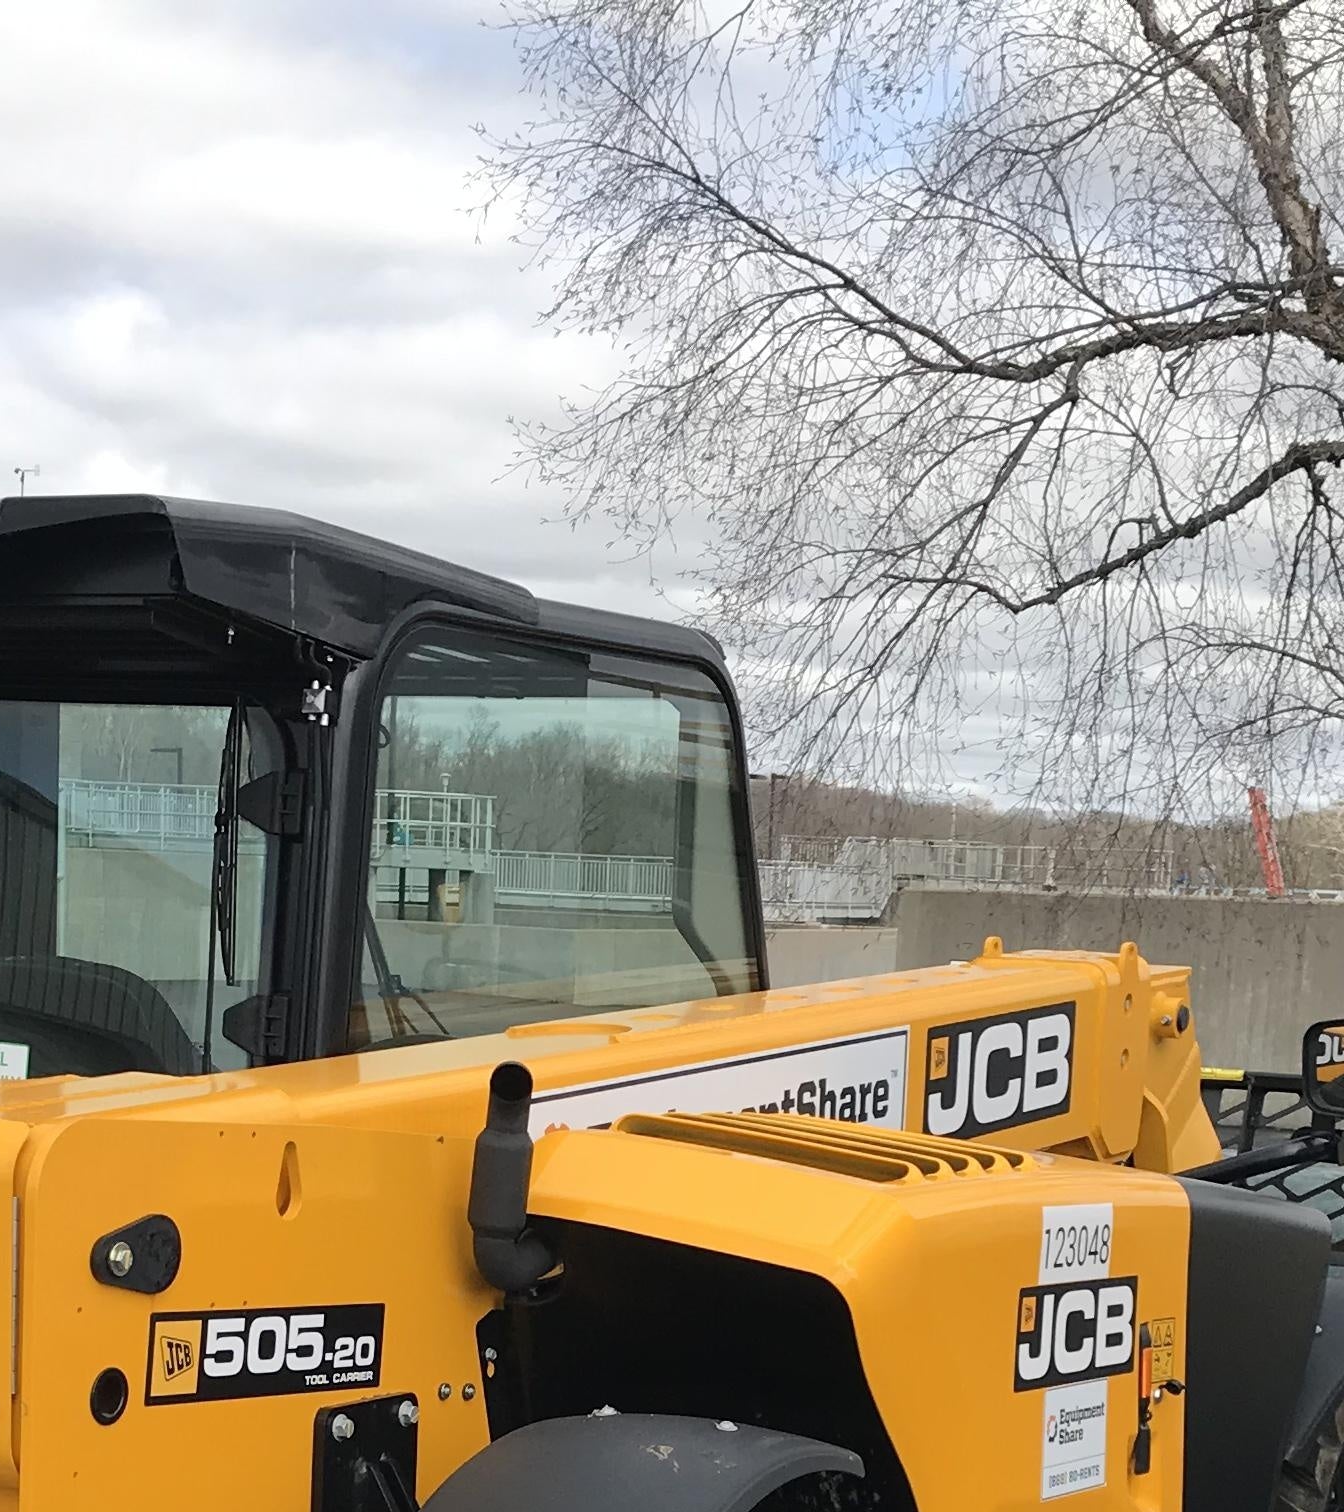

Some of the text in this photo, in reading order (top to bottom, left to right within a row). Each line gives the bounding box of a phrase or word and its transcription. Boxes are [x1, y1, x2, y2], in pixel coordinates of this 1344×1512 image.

[926, 1013, 1069, 1135] JCB
[1044, 1223, 1110, 1270] 123048
[1018, 1285, 1134, 1381] JCB
[165, 1340, 192, 1376] JCB
[304, 1370, 374, 1386] TOOL CARRIER
[1059, 1402, 1105, 1427] Equipment
[1058, 1428, 1084, 1446] Share
